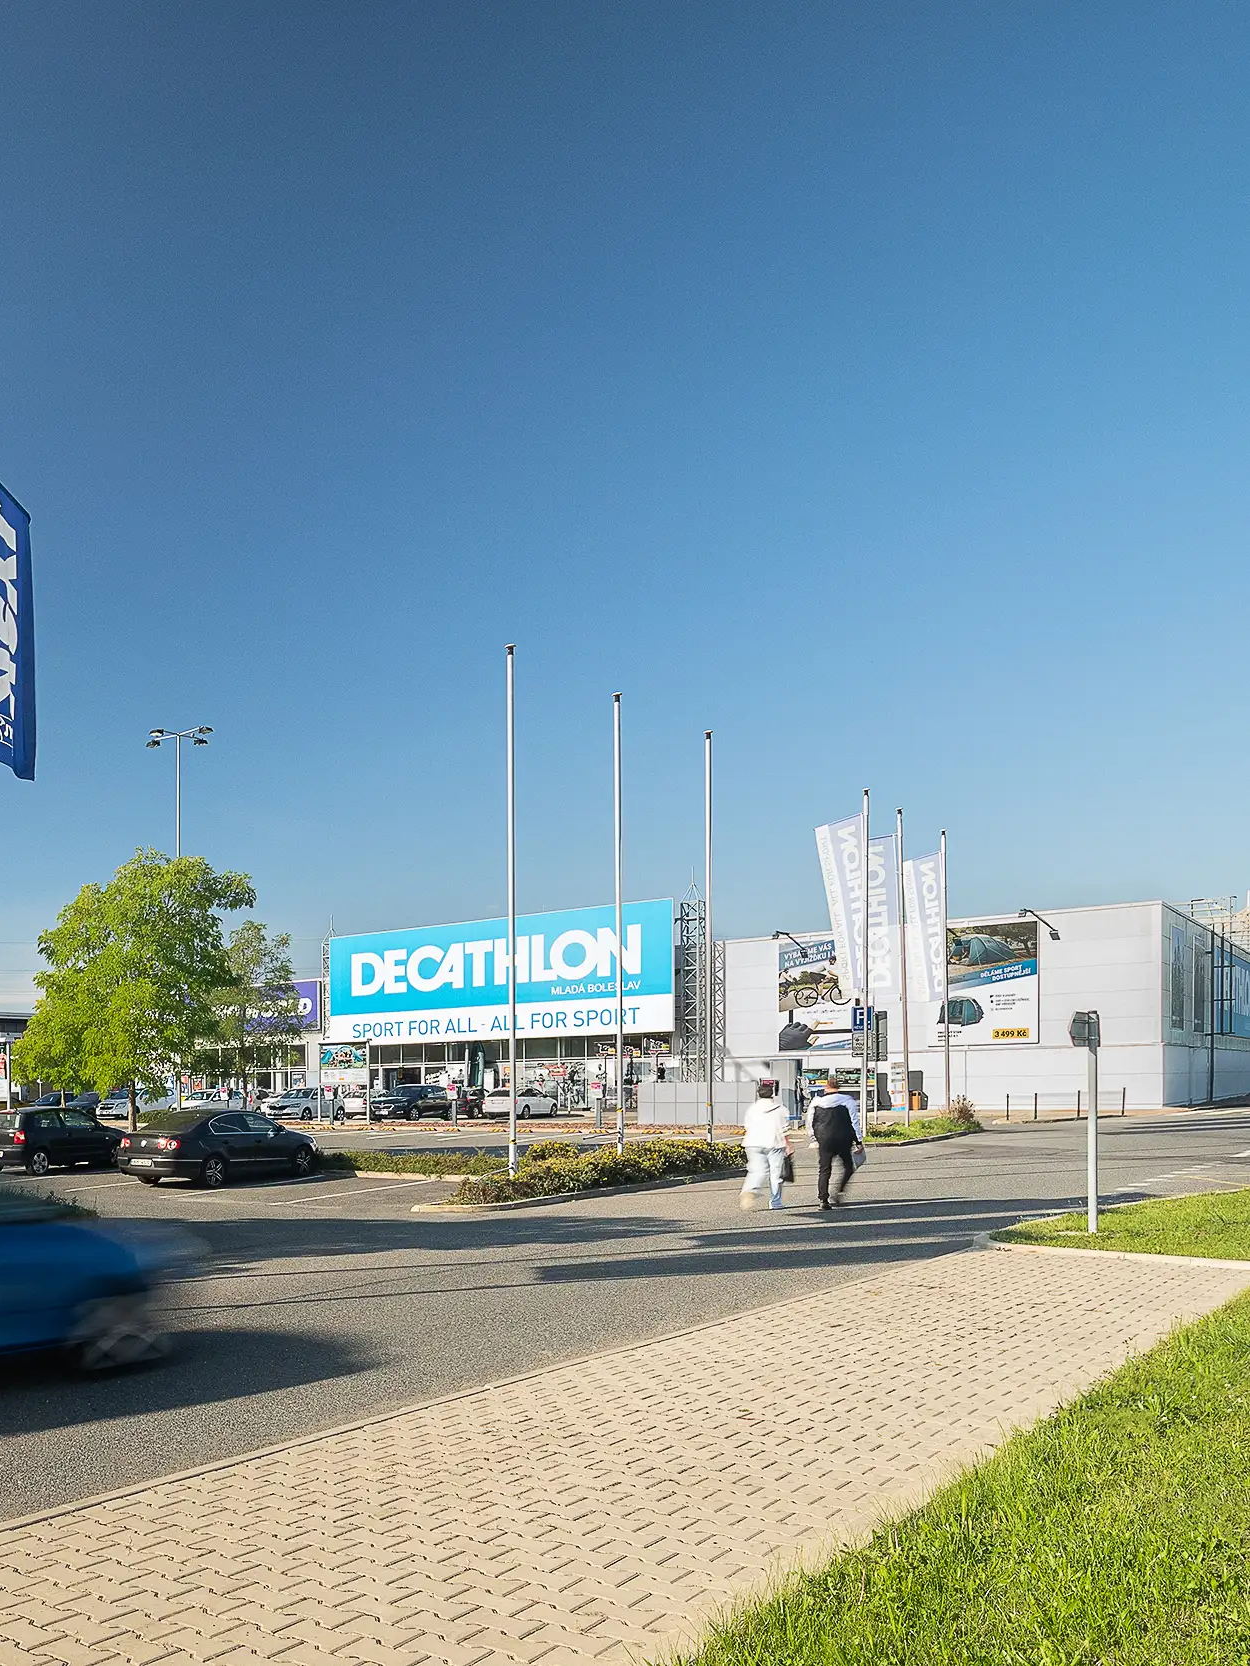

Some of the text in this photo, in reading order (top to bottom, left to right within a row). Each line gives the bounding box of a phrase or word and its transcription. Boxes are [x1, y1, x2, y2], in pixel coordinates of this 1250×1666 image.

[351, 923, 642, 997] DECATHLON
[1004, 964, 1023, 973] SPORT
[551, 982, 585, 995] MLADÁ
[352, 1021, 404, 1039] SPORT
[408, 1019, 440, 1036] FOR
[445, 1017, 478, 1034] ALL
[490, 1015, 525, 1032] ALL
[531, 1011, 568, 1030] FOR
[573, 1007, 641, 1028] SPORT
[1000, 1029, 1015, 1038] 499
[1016, 1028, 1027, 1037] Kč
